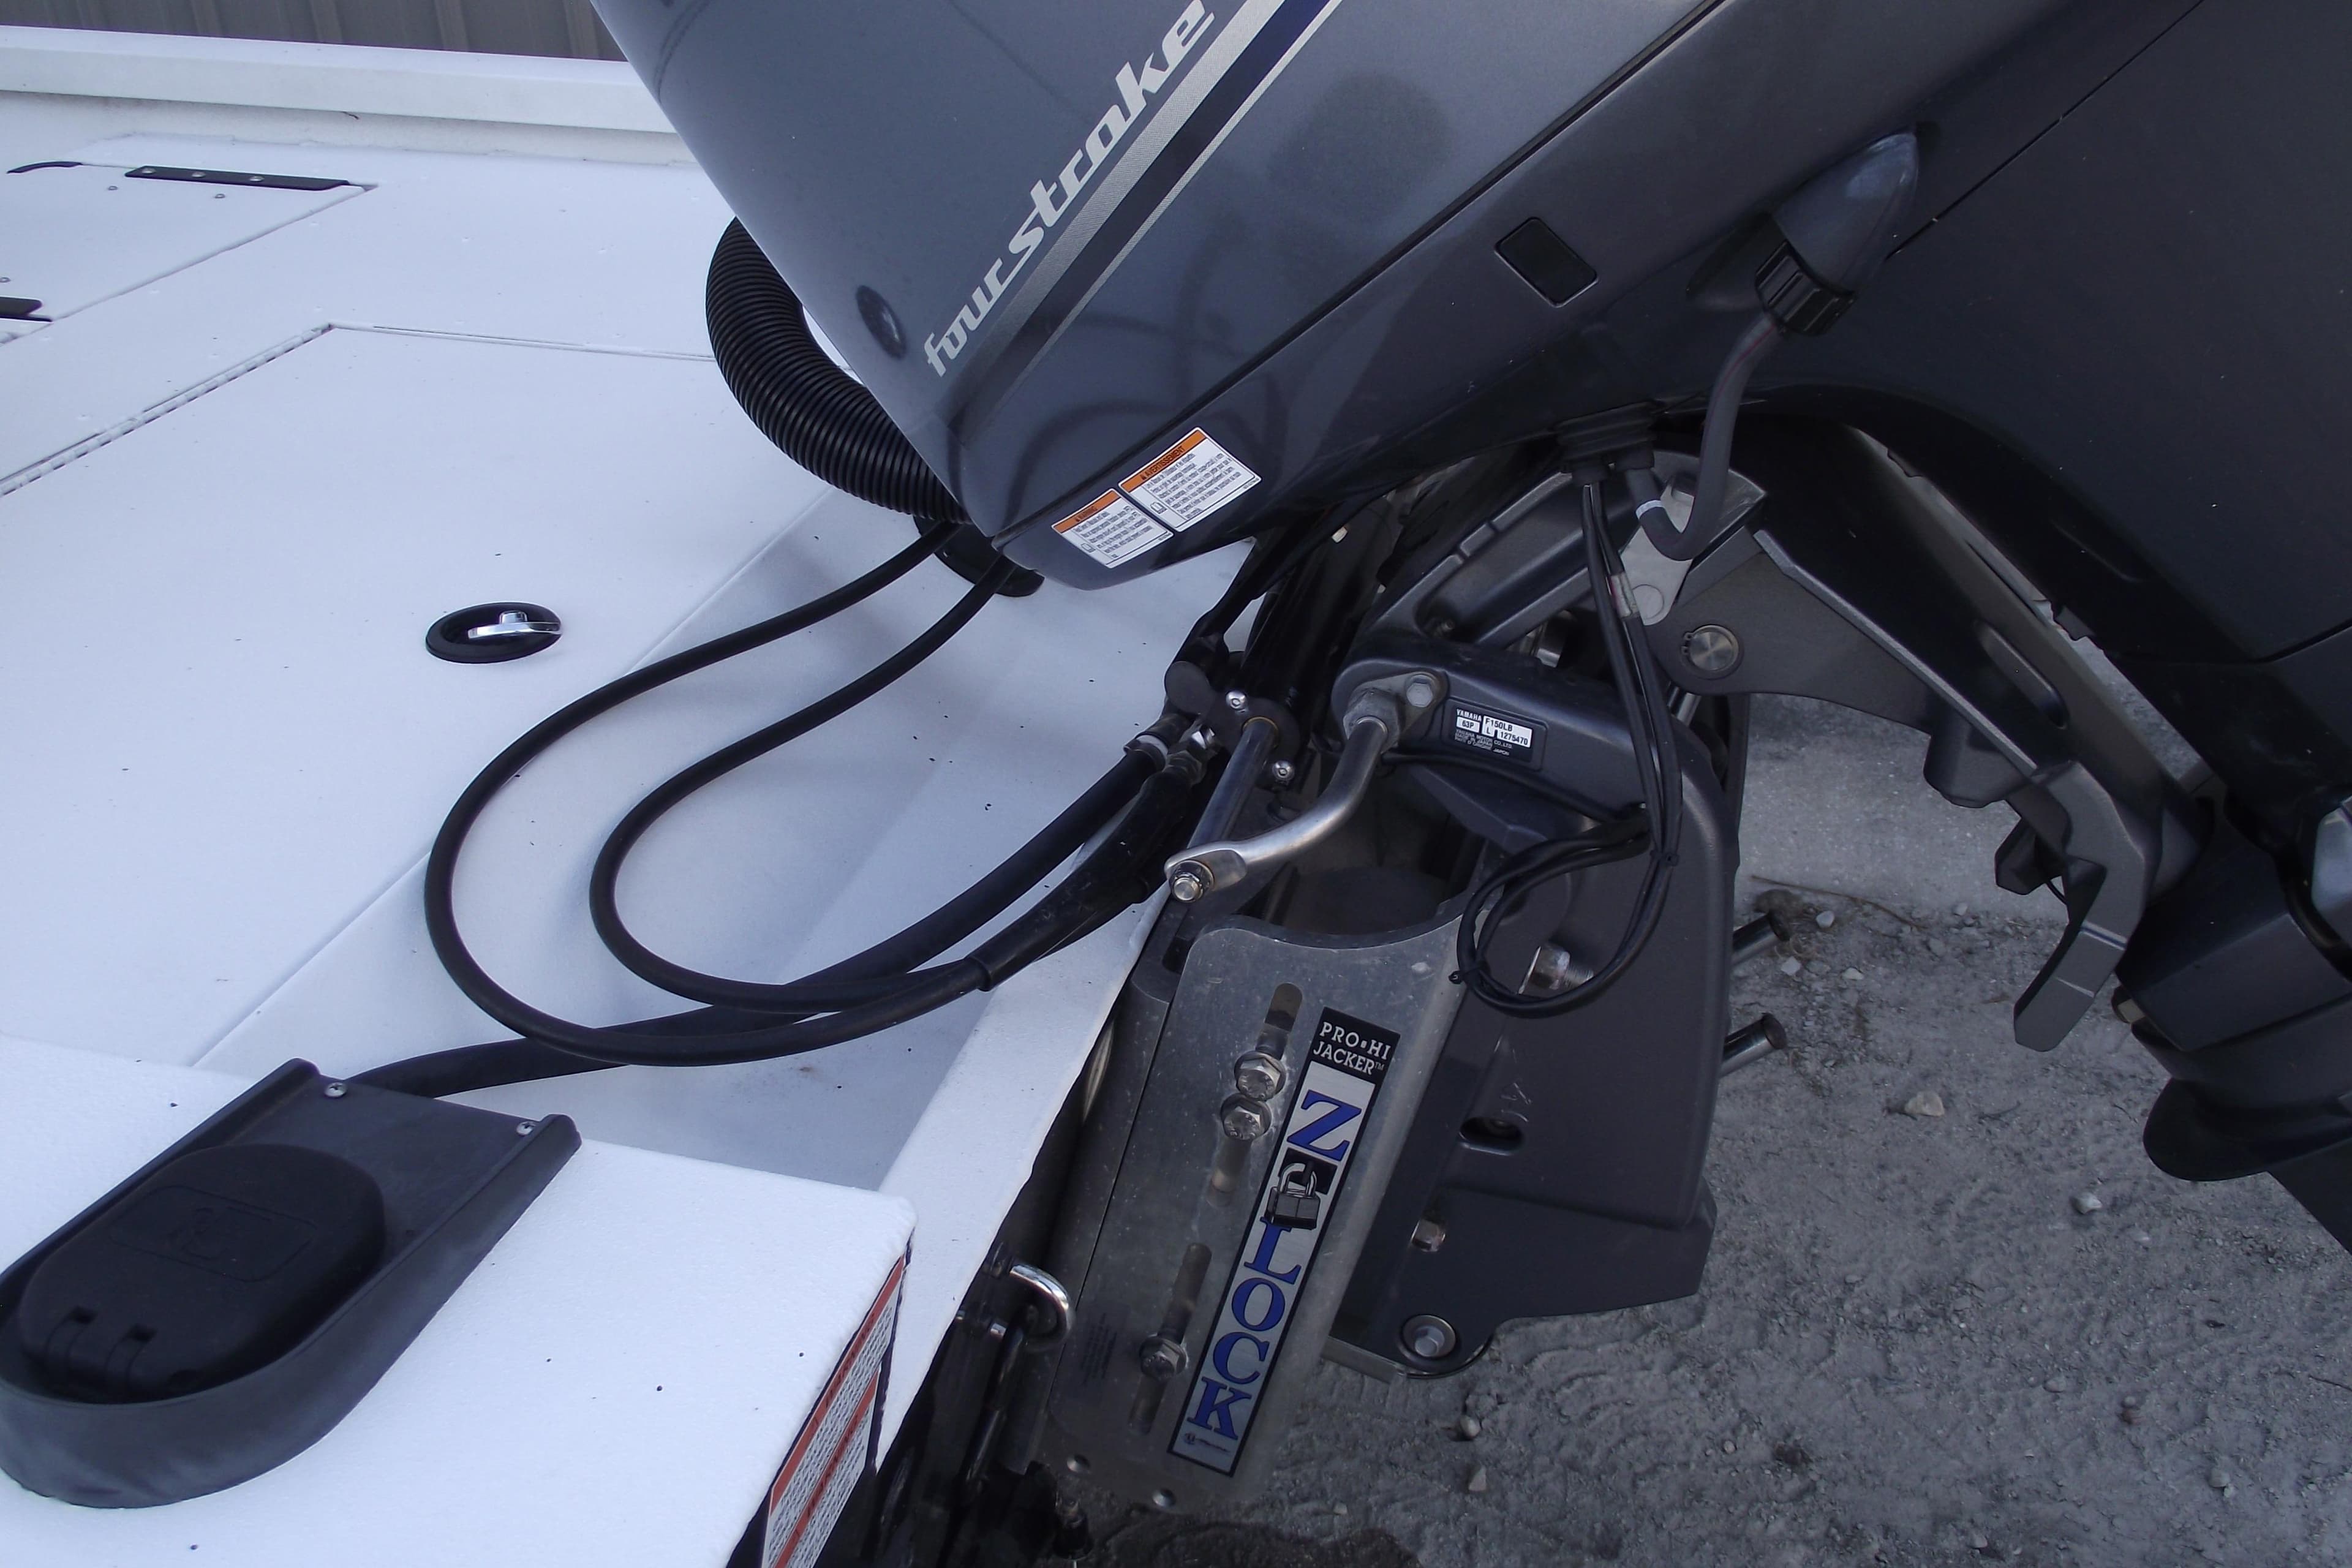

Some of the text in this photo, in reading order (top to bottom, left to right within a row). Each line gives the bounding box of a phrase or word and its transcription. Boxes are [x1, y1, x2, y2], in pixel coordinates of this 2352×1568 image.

[1457, 709, 1482, 722] YAMAHA
[1461, 720, 1474, 729] 63P
[1485, 718, 1513, 731] F150LB
[1500, 732, 1528, 745] 1275470
[1186, 1216, 1302, 1440] LOCK
